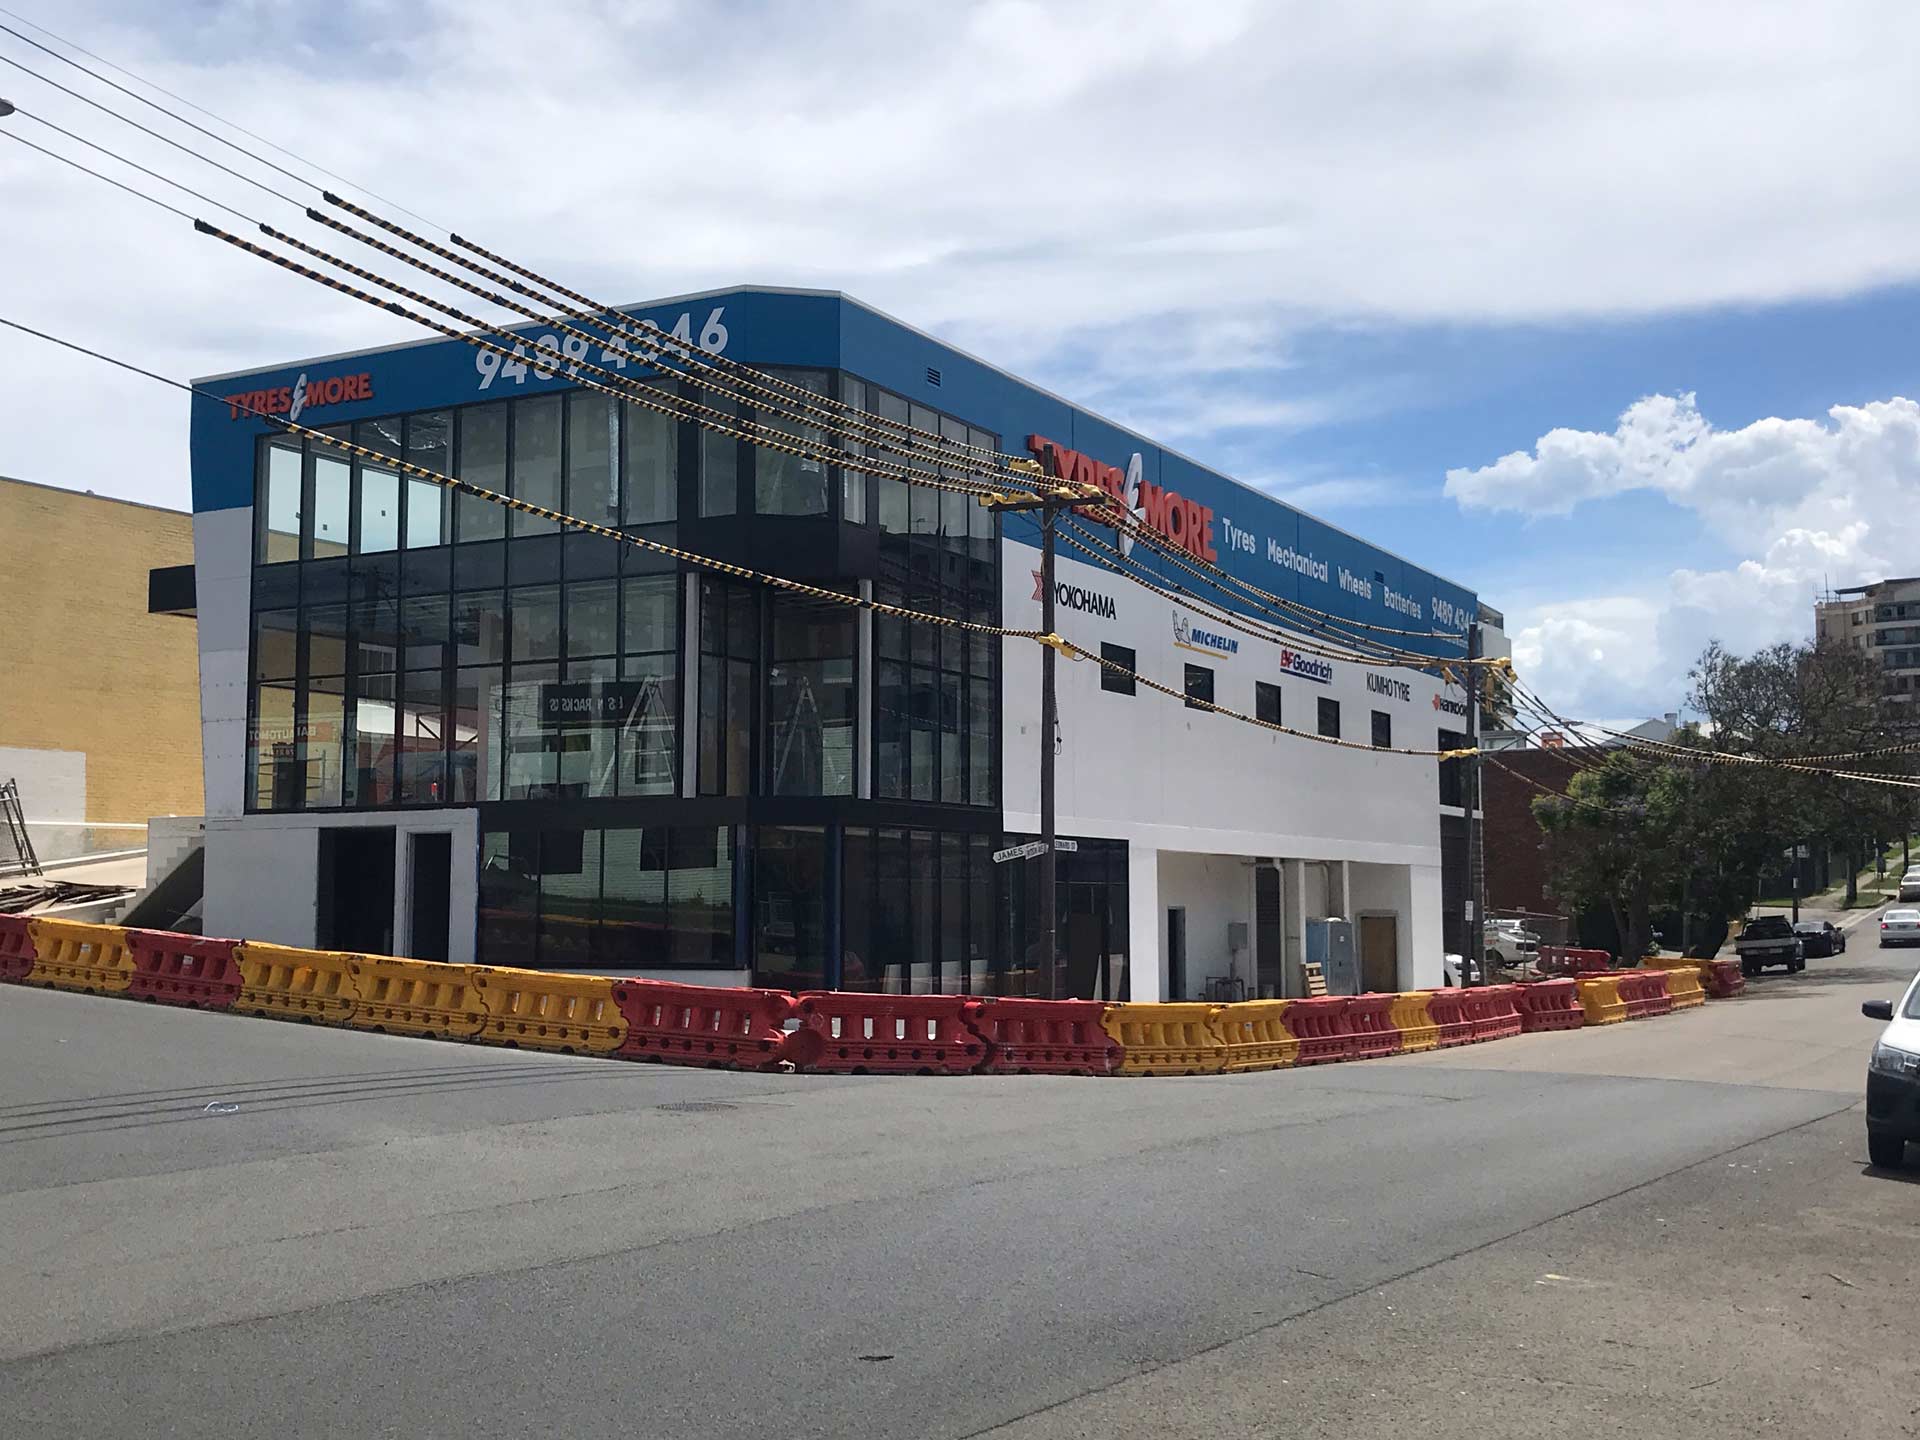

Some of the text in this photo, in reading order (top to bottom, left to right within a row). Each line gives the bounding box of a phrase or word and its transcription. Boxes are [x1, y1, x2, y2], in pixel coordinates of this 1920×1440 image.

[476, 306, 729, 391] 9489 4346
[1222, 517, 1256, 554] Tyres
[1267, 536, 1329, 584] Mechanical
[1337, 565, 1372, 600] Wheels
[1384, 585, 1422, 620] Batteries
[1431, 596, 1454, 627] 9489
[1053, 581, 1117, 620] YOKOHAMA
[1191, 627, 1239, 654] MICHELIN
[1279, 650, 1333, 680] BFGoodrich
[1366, 671, 1410, 702] KUMHO TYRE
[997, 847, 1024, 861] JAMES
